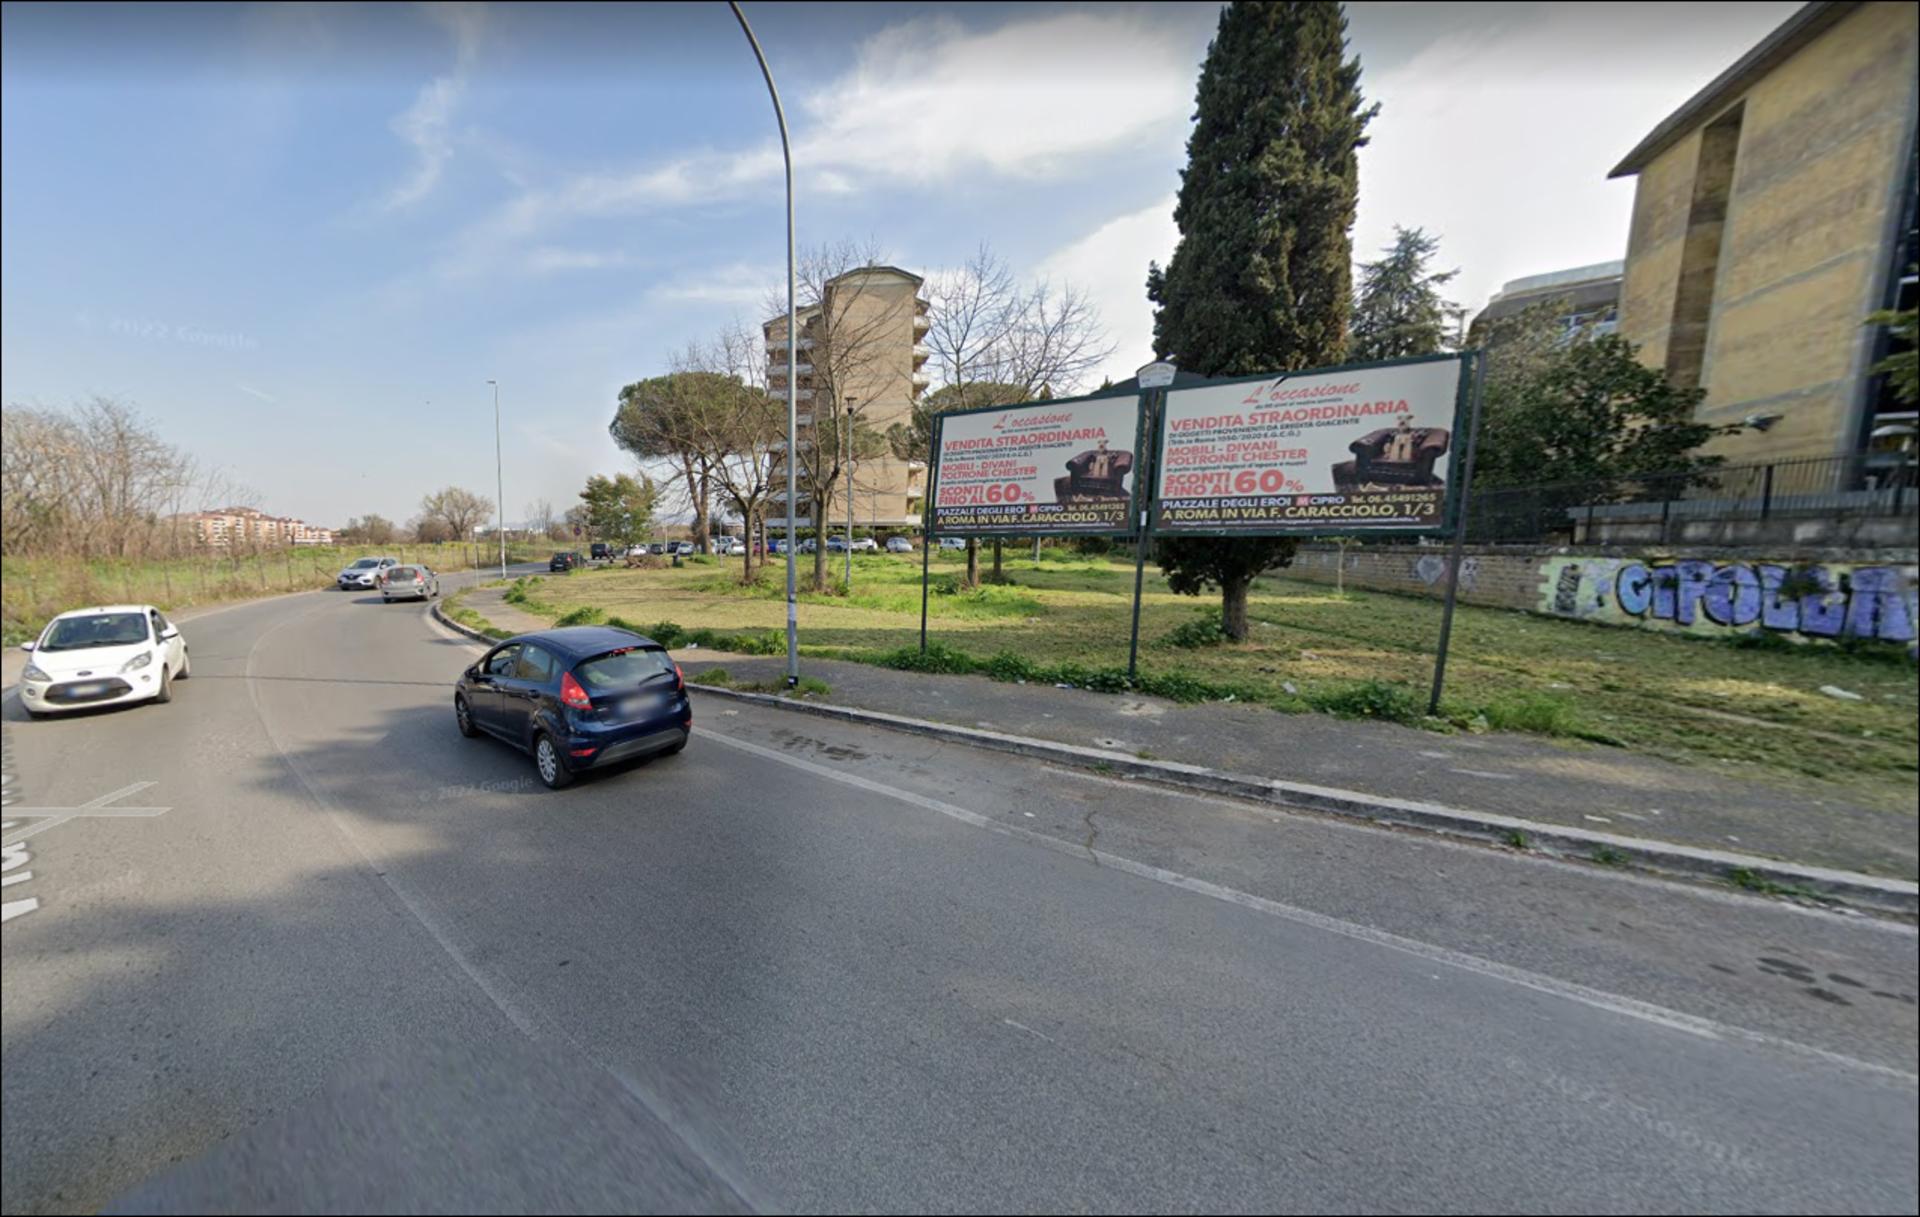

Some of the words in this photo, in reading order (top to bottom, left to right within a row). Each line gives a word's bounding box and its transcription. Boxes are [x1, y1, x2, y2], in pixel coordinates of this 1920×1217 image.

[1242, 384, 1361, 405] L'occasione
[1171, 415, 1244, 431] VENDITA
[1248, 400, 1409, 425] STRAORDINARIA
[944, 438, 993, 451] VENDITA
[996, 427, 1106, 447] STRAORDINARIA
[1167, 446, 1216, 456] MOBILI
[1226, 441, 1278, 453] DIVANI
[1166, 453, 1239, 466] POLTRONE
[1241, 448, 1308, 461] CHESTER
[942, 463, 975, 471] MOBILI
[981, 460, 1017, 469] DIVANI
[941, 470, 989, 480] POLTRONE
[991, 466, 1037, 476] CHESTER
[1166, 472, 1231, 486] SCONTI
[1164, 484, 1206, 497] FINO
[1210, 483, 1233, 495] AL
[1234, 468, 1304, 494] 60%
[940, 485, 984, 496] SCONTI
[938, 495, 967, 505] FINO
[969, 495, 985, 504] AL
[1162, 499, 1219, 509] PIAZZALE
[1221, 498, 1257, 507] DEGLI
[1260, 497, 1291, 506] EROI
[1310, 496, 1345, 505] CIPRO
[937, 508, 975, 516] PIAZZALE
[977, 507, 1003, 515] DEGLI
[1004, 505, 1026, 513] EROI
[1162, 509, 1172, 520] A
[1175, 509, 1219, 519] ROMA
[1222, 508, 1238, 518] IN
[1241, 508, 1266, 518] VIA
[1269, 507, 1281, 517] F.
[1285, 504, 1398, 517] CARACCIOLO,
[1404, 502, 1435, 516] 1/3
[937, 516, 944, 525] A
[945, 515, 976, 525] ROMA
[978, 514, 988, 523] IN
[990, 514, 1010, 523] VIA
[1011, 514, 1020, 523] F.
[1022, 511, 1100, 523] CARACCIOLO,
[1104, 511, 1124, 521] 1/3
